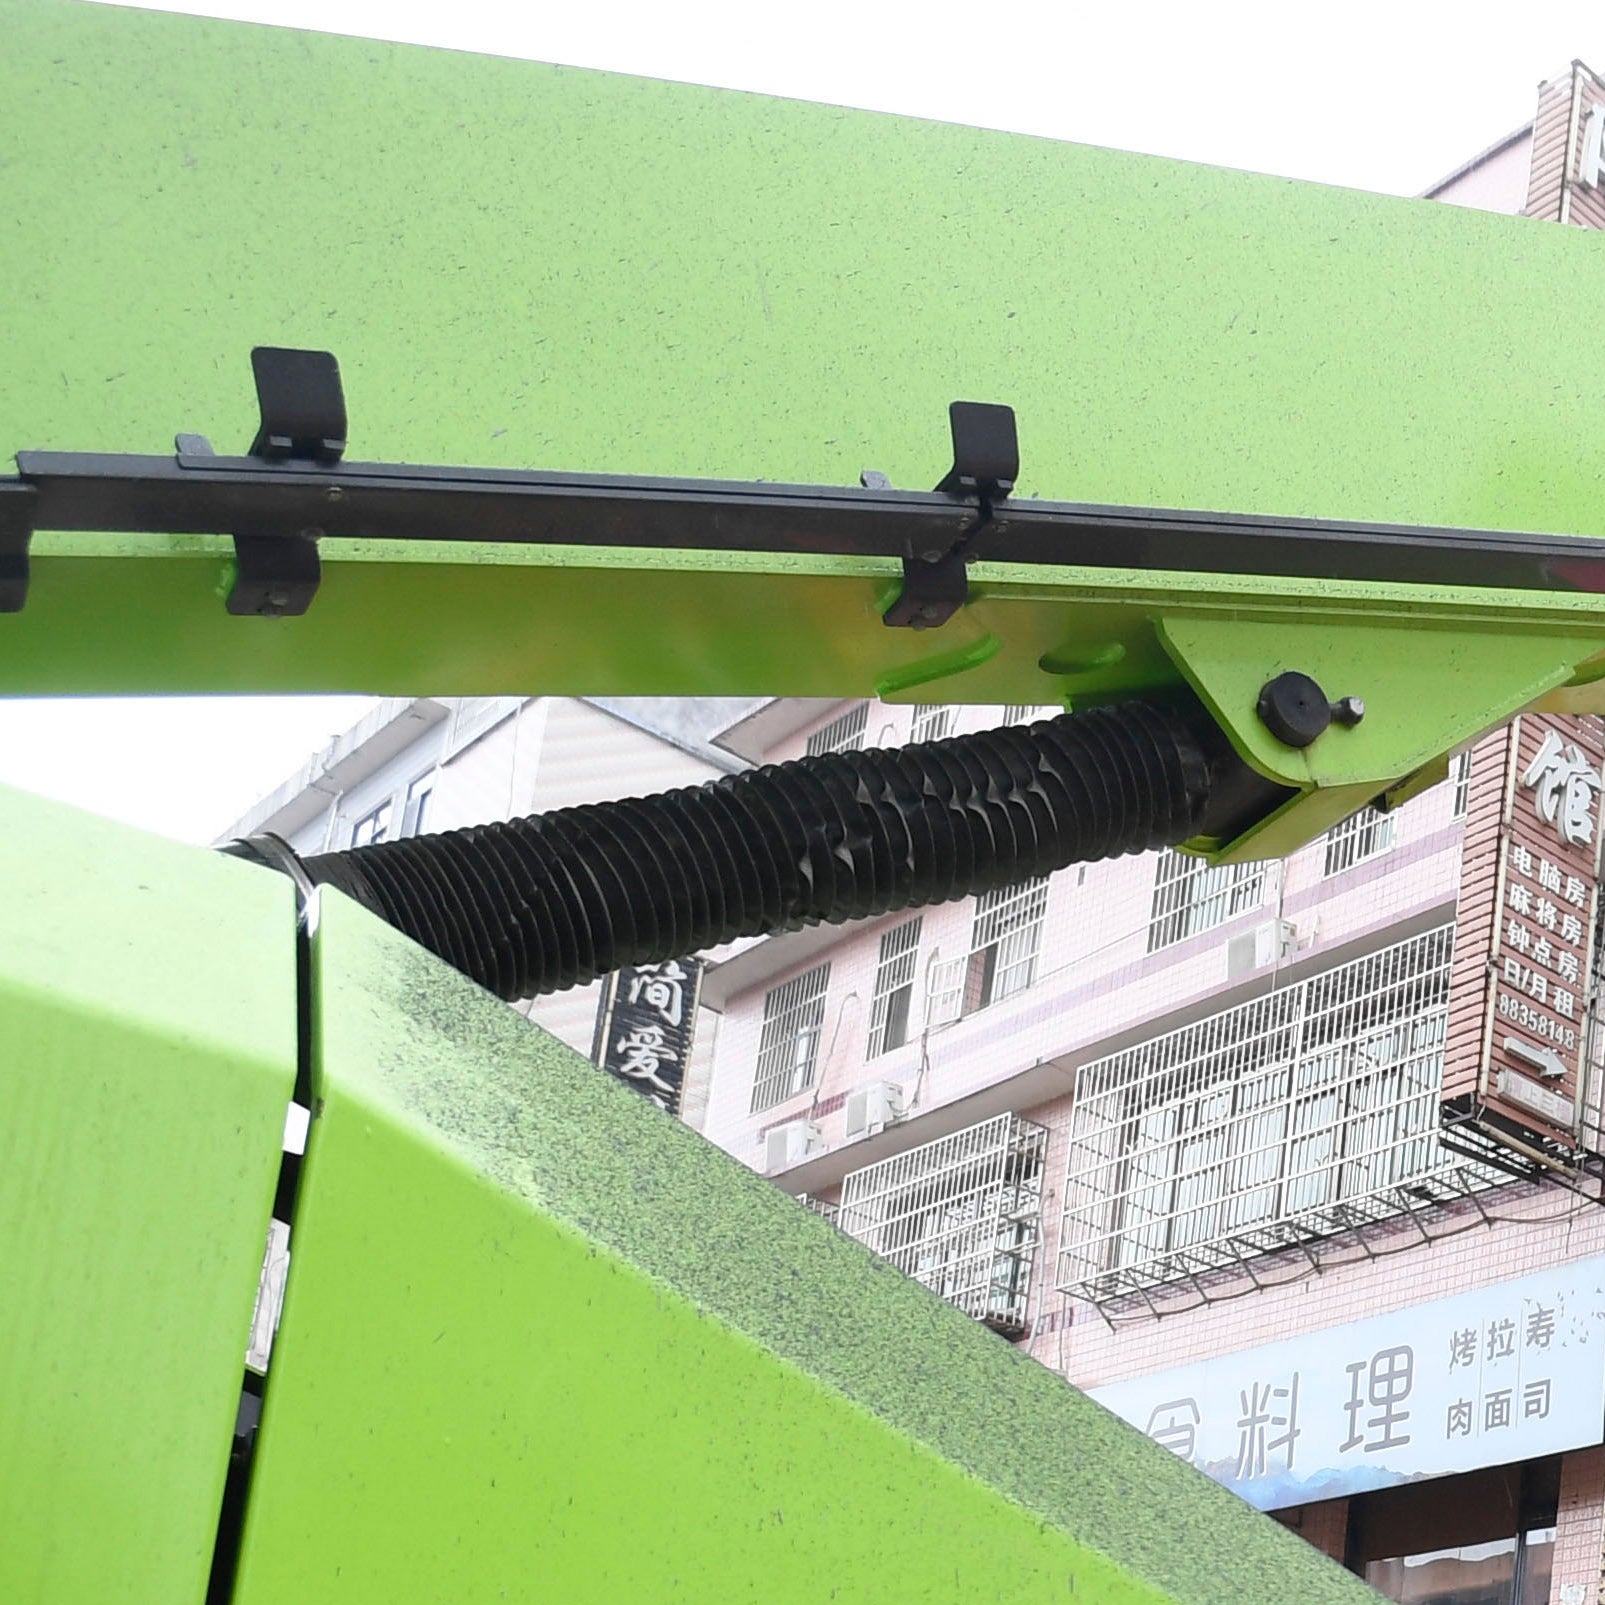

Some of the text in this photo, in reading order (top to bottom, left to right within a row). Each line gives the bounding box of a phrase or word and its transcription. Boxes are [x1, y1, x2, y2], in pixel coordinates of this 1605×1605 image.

[1523, 730, 1603, 846] 馆
[1512, 845, 1587, 908] 电脑房
[1508, 882, 1584, 946] 麻将房
[1505, 918, 1582, 987] 钟点房
[1502, 955, 1576, 1019] 日/月租
[616, 963, 684, 1109] 简爱
